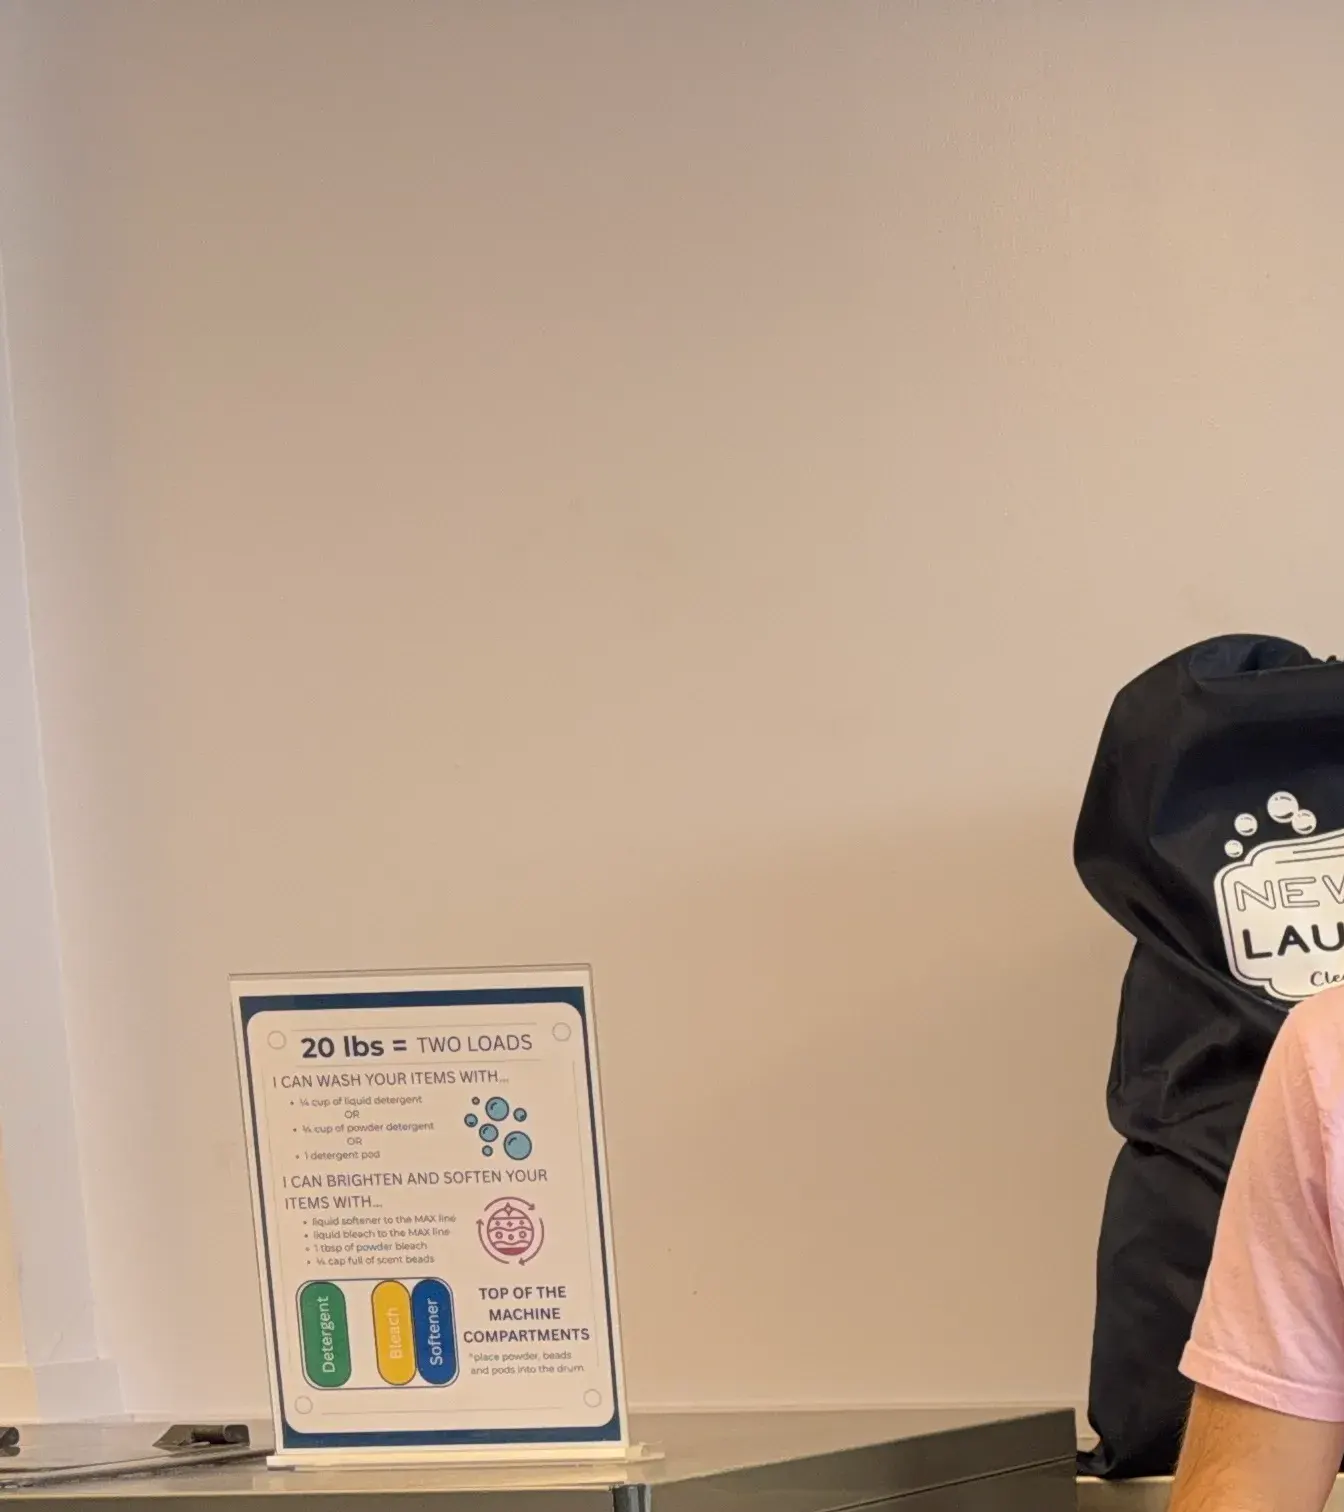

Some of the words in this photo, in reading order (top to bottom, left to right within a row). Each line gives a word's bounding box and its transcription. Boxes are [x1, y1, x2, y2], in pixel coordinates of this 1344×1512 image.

[300, 1037, 334, 1059] 20
[344, 1036, 384, 1058] lbs
[416, 1036, 461, 1053] TWO
[468, 1034, 533, 1052] LOADS
[281, 1076, 312, 1088] CAN
[317, 1074, 361, 1087] WASH
[365, 1072, 406, 1086] YOUR
[411, 1071, 455, 1084] ITEMS
[344, 1096, 371, 1109] liquid
[374, 1096, 422, 1107] detergent
[344, 1110, 360, 1119] OR
[315, 1126, 333, 1135] cup
[335, 1124, 344, 1132] of
[347, 1124, 383, 1134] powder
[386, 1122, 434, 1133] detergent
[347, 1137, 362, 1146] OR
[311, 1150, 358, 1162] detergent
[362, 1150, 380, 1160] pod
[291, 1175, 322, 1188] CAN
[327, 1173, 403, 1187] BRIGHTEN
[407, 1172, 439, 1185] AND
[443, 1170, 502, 1184] SOFTEN
[505, 1169, 548, 1183] YOUR
[285, 1196, 329, 1210] ITEMS
[312, 1217, 339, 1227] liquid
[342, 1216, 380, 1226] softener
[384, 1216, 393, 1224] to
[396, 1215, 412, 1224] the
[415, 1215, 436, 1223] MAX
[438, 1214, 456, 1222] line
[314, 1230, 340, 1240] liquid
[343, 1229, 375, 1238] bleach
[377, 1229, 387, 1238] to
[390, 1229, 406, 1237] the
[408, 1228, 430, 1236] MAX
[433, 1227, 450, 1236] line
[344, 1242, 354, 1251] of
[357, 1242, 392, 1252] powder
[395, 1241, 428, 1250] bleach
[329, 1257, 345, 1266] cap
[348, 1256, 363, 1265] full
[366, 1256, 374, 1264] of
[377, 1255, 402, 1264] scent
[406, 1254, 435, 1264] beads
[479, 1287, 508, 1300] TOP
[513, 1286, 532, 1299] OF
[536, 1286, 566, 1298] THE
[489, 1308, 561, 1321] MACHINE
[322, 1296, 336, 1373] Detergent
[389, 1307, 403, 1360] Bleach
[427, 1298, 443, 1366] Softener
[463, 1328, 590, 1343] COMPARTMENTS
[542, 1351, 572, 1360] beads
[471, 1366, 488, 1375] and
[492, 1365, 515, 1376] pods
[518, 1365, 536, 1374] into
[538, 1364, 554, 1373] the
